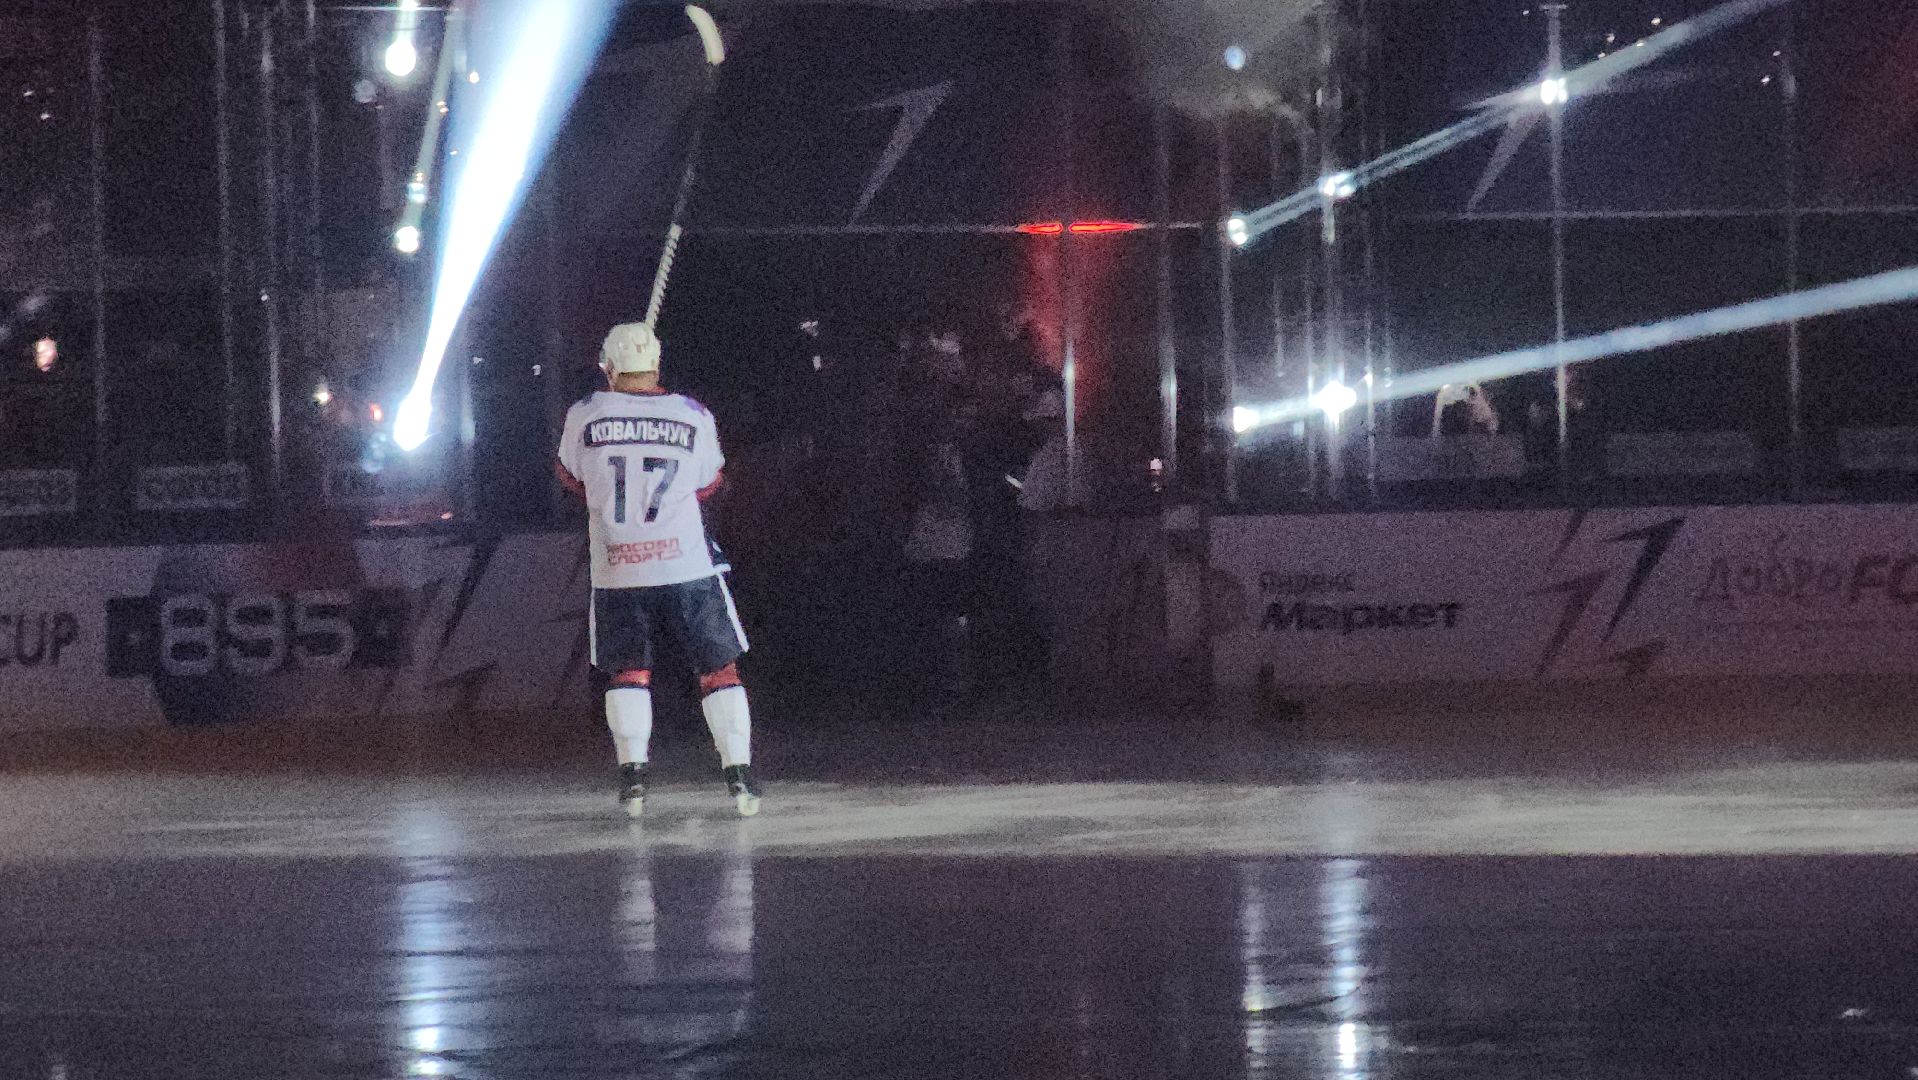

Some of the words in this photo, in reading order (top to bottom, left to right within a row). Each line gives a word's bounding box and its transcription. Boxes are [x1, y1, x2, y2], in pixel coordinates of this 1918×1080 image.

[590, 420, 690, 447] КОВАЛЬЧУК
[607, 455, 679, 524] 17
[160, 589, 356, 677] 895
[1259, 602, 1462, 635] Маркет
